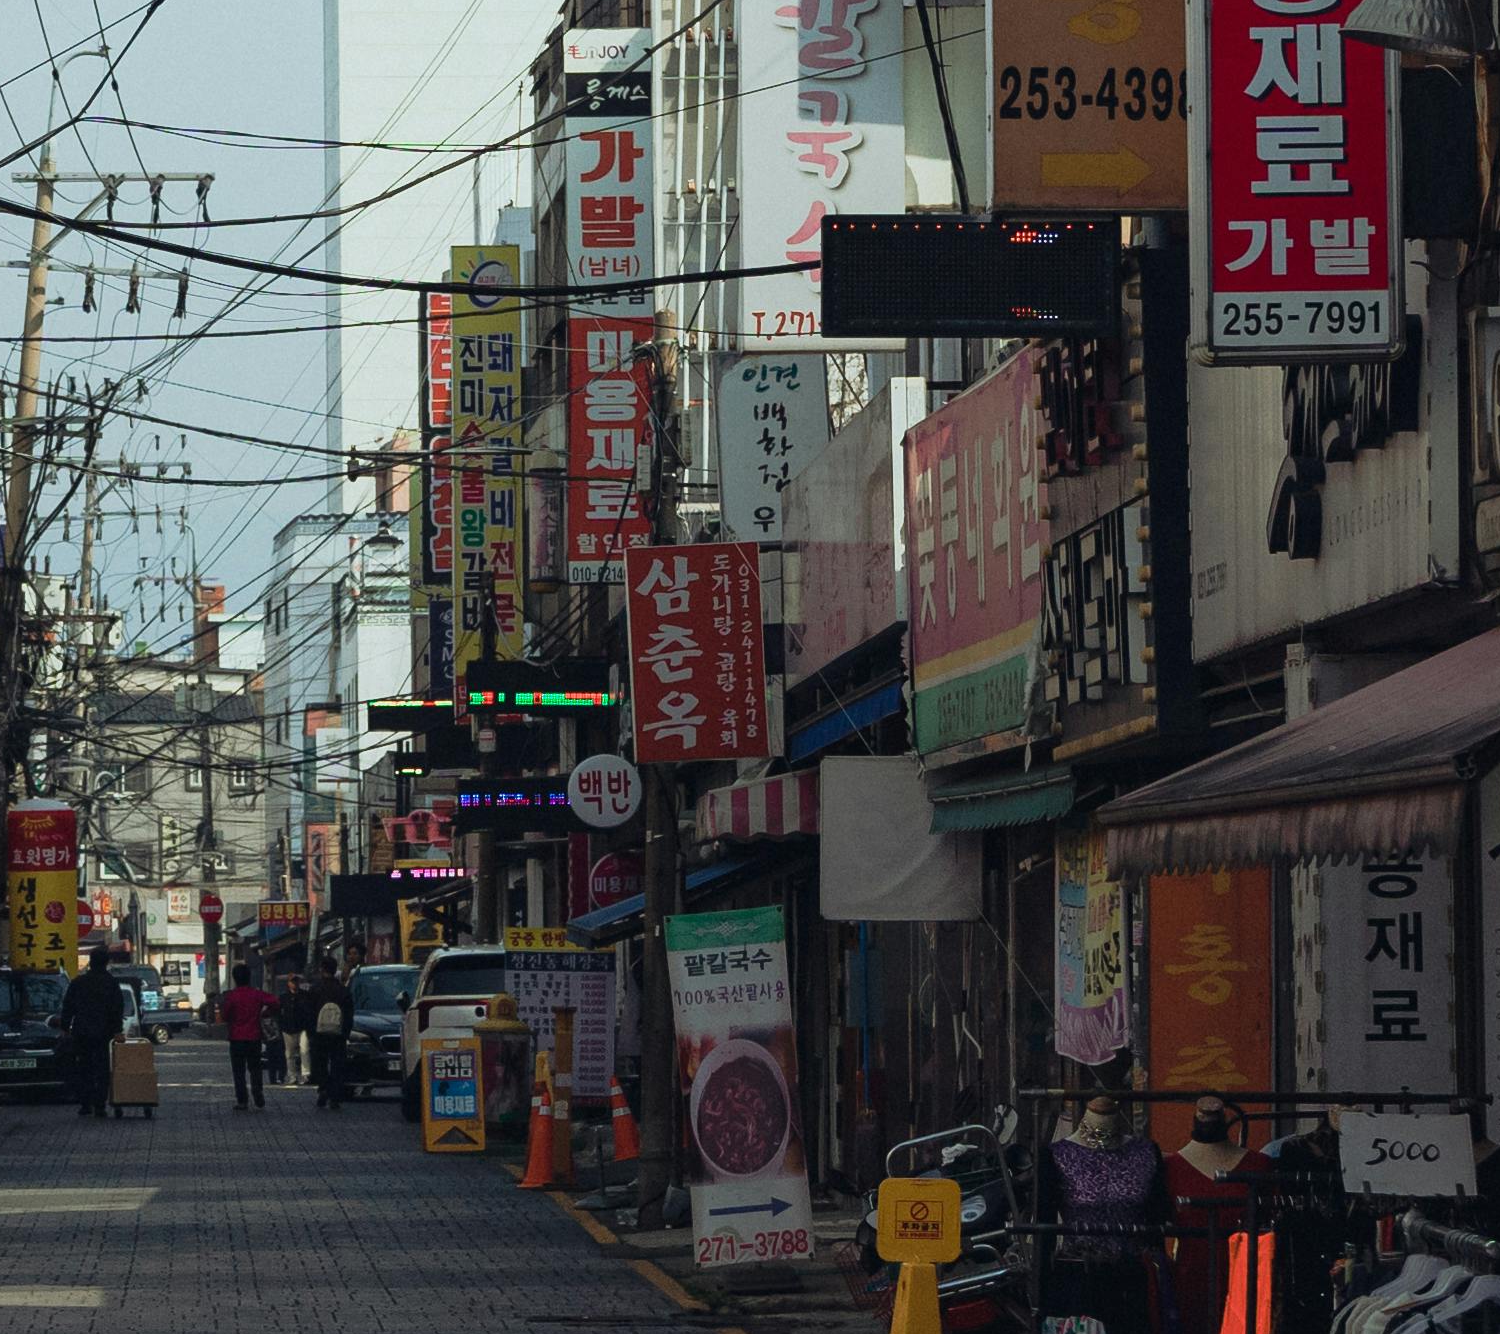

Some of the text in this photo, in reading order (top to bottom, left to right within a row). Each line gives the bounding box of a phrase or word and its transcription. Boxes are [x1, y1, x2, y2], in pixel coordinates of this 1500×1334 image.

[580, 131, 644, 249] 가발
[1225, 216, 1375, 277] 가발
[579, 254, 640, 277] (남녀)
[1223, 302, 1382, 336] 255-7991
[585, 331, 637, 521] 미용재료
[635, 555, 706, 749] 삼춘옥
[578, 769, 631, 814] 백반
[12, 846, 72, 866] 효원명가
[683, 949, 773, 978] 팥칼국수
[1365, 1138, 1441, 1165] 5000
[698, 1229, 808, 1263] 271-3788
